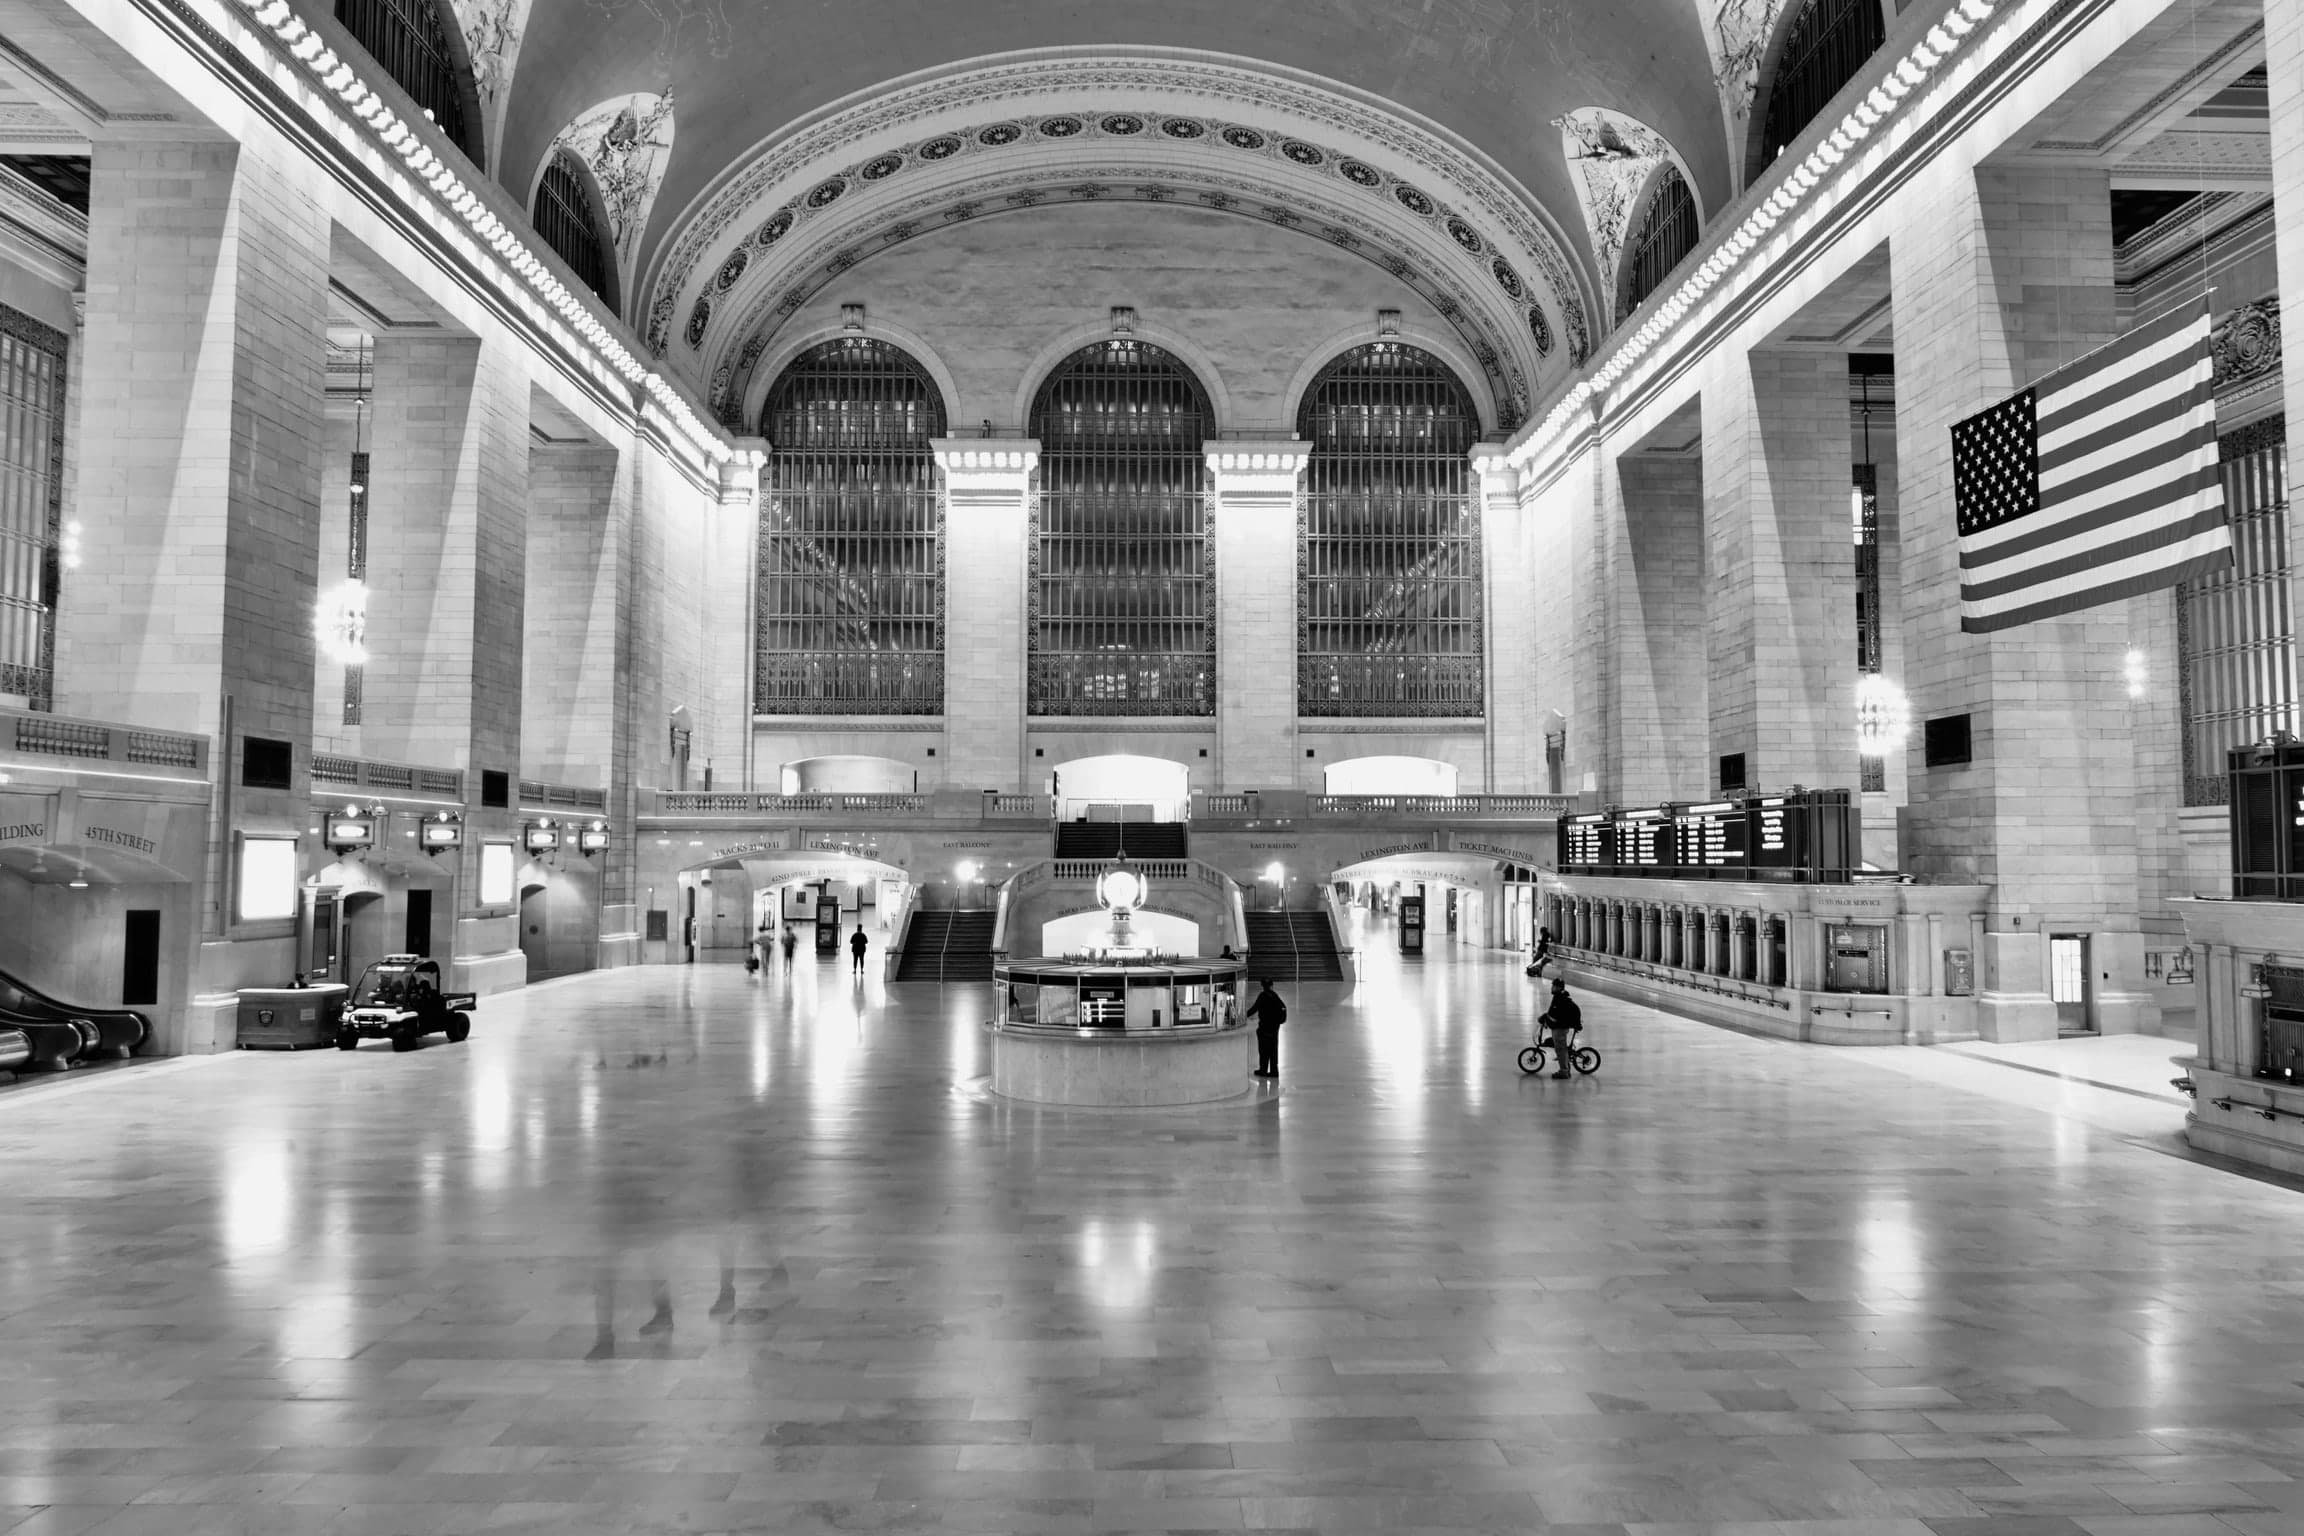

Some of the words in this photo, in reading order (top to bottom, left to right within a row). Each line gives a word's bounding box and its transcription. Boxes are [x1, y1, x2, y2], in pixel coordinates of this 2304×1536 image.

[85, 826, 114, 842] 45TH
[115, 831, 157, 854] STREET
[810, 840, 861, 855] LEXINGTON
[713, 844, 748, 857] TRACKS
[1360, 843, 1411, 859] LEXINGTON
[1412, 841, 1429, 850] AVE
[1459, 841, 1489, 852] TICKET
[1490, 845, 1534, 862] MACHINES
